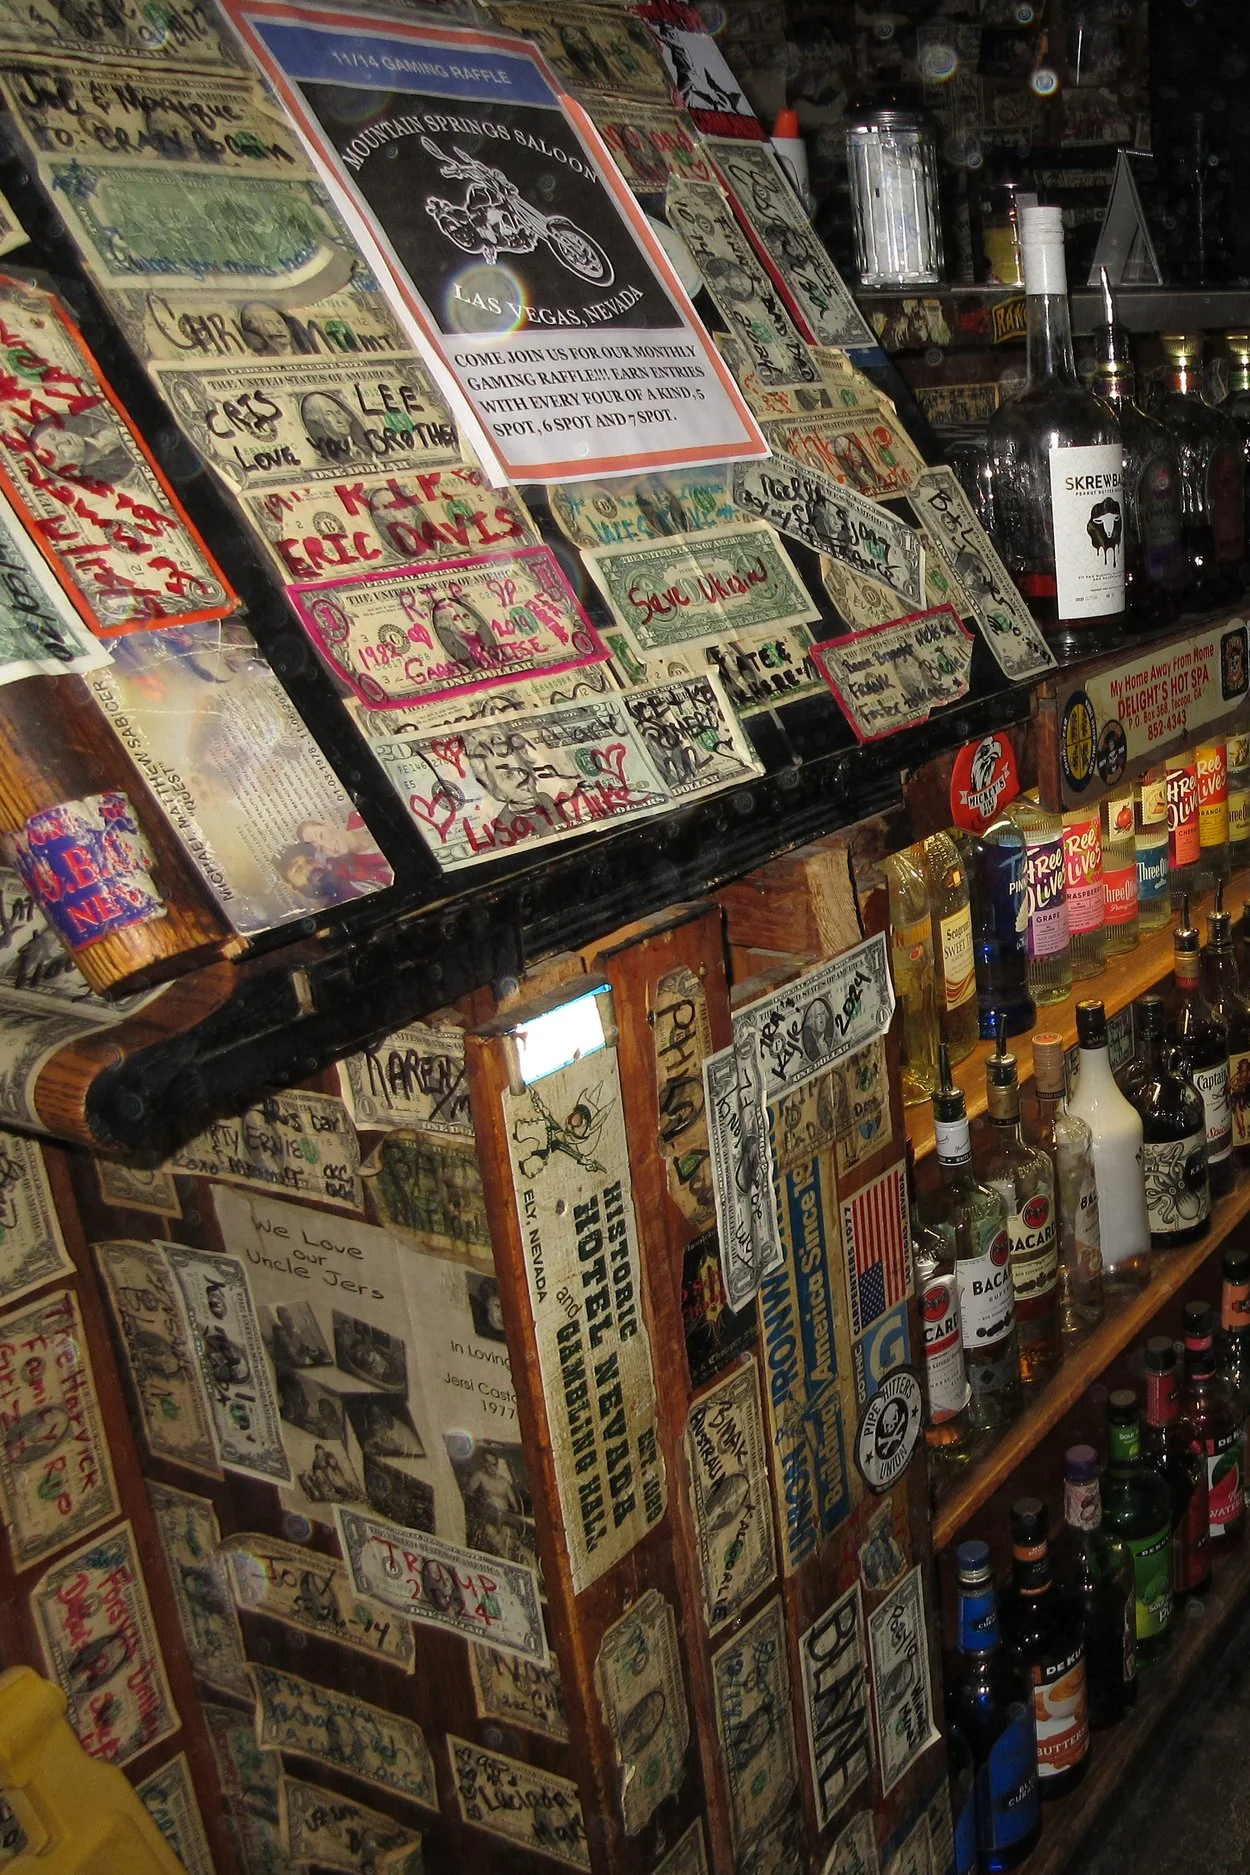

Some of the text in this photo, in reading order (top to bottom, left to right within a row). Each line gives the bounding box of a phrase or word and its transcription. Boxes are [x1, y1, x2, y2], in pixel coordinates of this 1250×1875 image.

[332, 50, 512, 85] 11/14 GAMING RAFFLE
[341, 114, 598, 183] MOUNTAIN SPRINGS SALOON
[454, 283, 645, 328] LAS VEGAS, NEVADA
[454, 345, 697, 368] COME JOIN US FOR OUR MONTHLY
[207, 380, 238, 392] THE
[239, 377, 285, 390] UNITED
[286, 375, 327, 387] STATES
[343, 370, 397, 382] AMERICA
[467, 365, 705, 392] GAMING RAFFLE!!! EARN ENTRIES
[479, 386, 706, 415] WITH EVERY FOUR OF A KIND, 5
[543, 417, 554, 433] 6
[554, 415, 593, 432] SPOT
[596, 413, 627, 429] AND
[629, 415, 638, 428] 7
[636, 408, 678, 424] SPOT.
[1065, 473, 1123, 491] SKREWBA
[387, 507, 527, 558] DAVIS
[275, 531, 383, 580] ERIC
[346, 595, 370, 606] THE
[370, 590, 408, 605] UNITED
[469, 568, 521, 589] AMERICA
[628, 586, 691, 625] Save
[357, 643, 404, 672] 1982
[1110, 643, 1215, 699] My Home Away From Home
[1117, 664, 1210, 721] DELIGHT'S HOT SPA
[1128, 715, 1143, 731] P.O.
[1143, 708, 1156, 723] Box
[1147, 709, 1188, 742] 852-4343
[1200, 807, 1222, 817] RANGE
[186, 836, 236, 902] MICHAEL
[1036, 910, 1061, 924] GRAPE
[944, 941, 966, 960] SWEET
[1196, 1065, 1229, 1091] Captain
[251, 1214, 365, 1260] We Love
[523, 1189, 548, 1305] ELY, NEVADA
[246, 1248, 386, 1301] Uncle Jers
[292, 1250, 328, 1267] our
[601, 1180, 639, 1343] HISTORIC
[844, 1206, 861, 1336] CARPENTERS 1977
[798, 1194, 834, 1381] America Since
[972, 1267, 1011, 1297] BACA
[556, 1286, 585, 1321] and
[449, 1339, 466, 1355] In
[573, 1194, 637, 1531] HOTEL NEVADA
[556, 1319, 599, 1477] GAMBLING
[863, 1382, 916, 1437] PIPE HITTERS
[816, 1397, 845, 1507] Building
[879, 1447, 907, 1481] UNION
[371, 1534, 499, 1595] TRUMP
